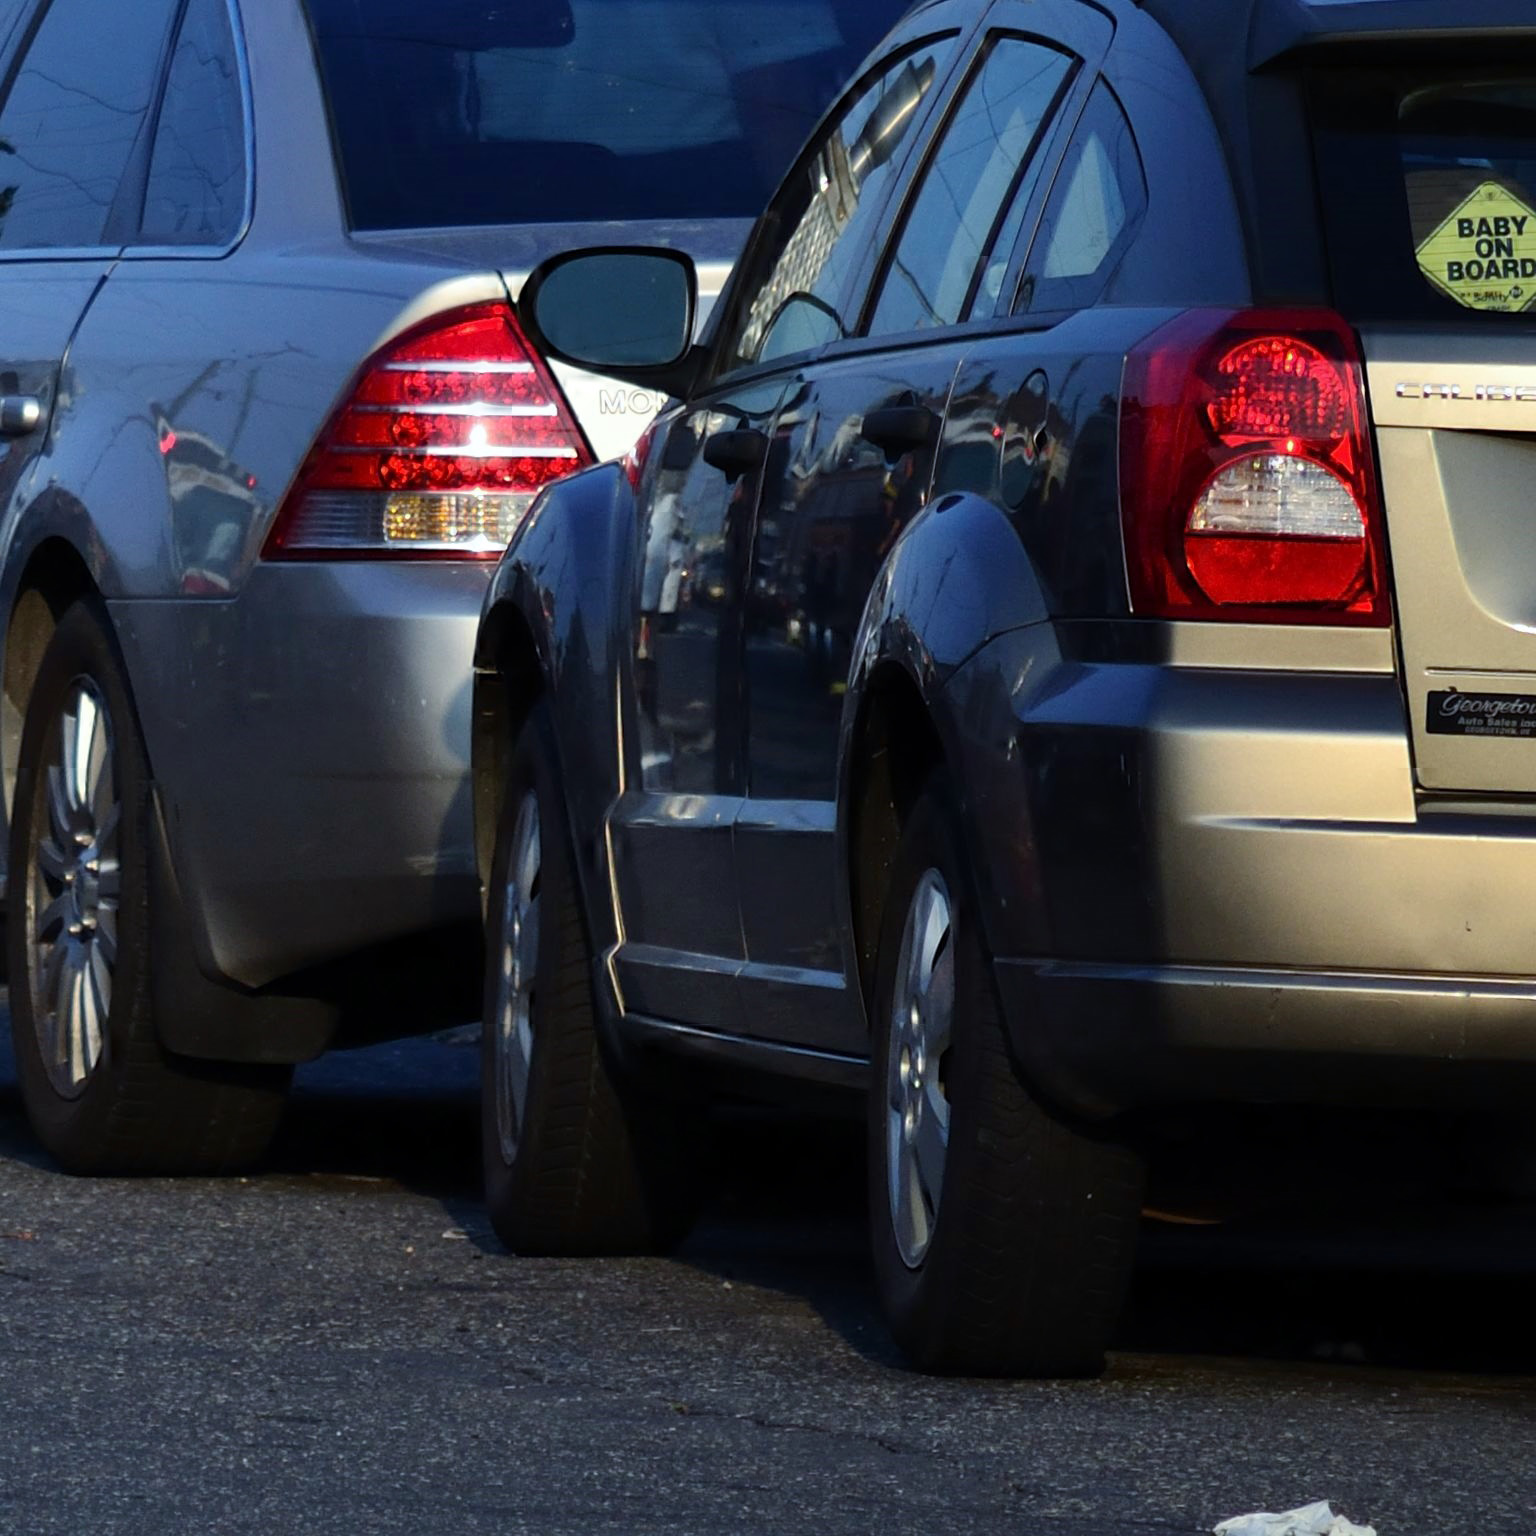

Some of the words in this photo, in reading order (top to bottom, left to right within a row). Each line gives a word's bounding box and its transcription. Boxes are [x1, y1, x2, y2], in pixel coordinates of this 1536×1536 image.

[1457, 215, 1528, 239] BABY
[1474, 237, 1514, 259] ON
[1446, 258, 1536, 282] BOARD
[1457, 716, 1485, 726] Auto
[1487, 717, 1518, 727] Sales
